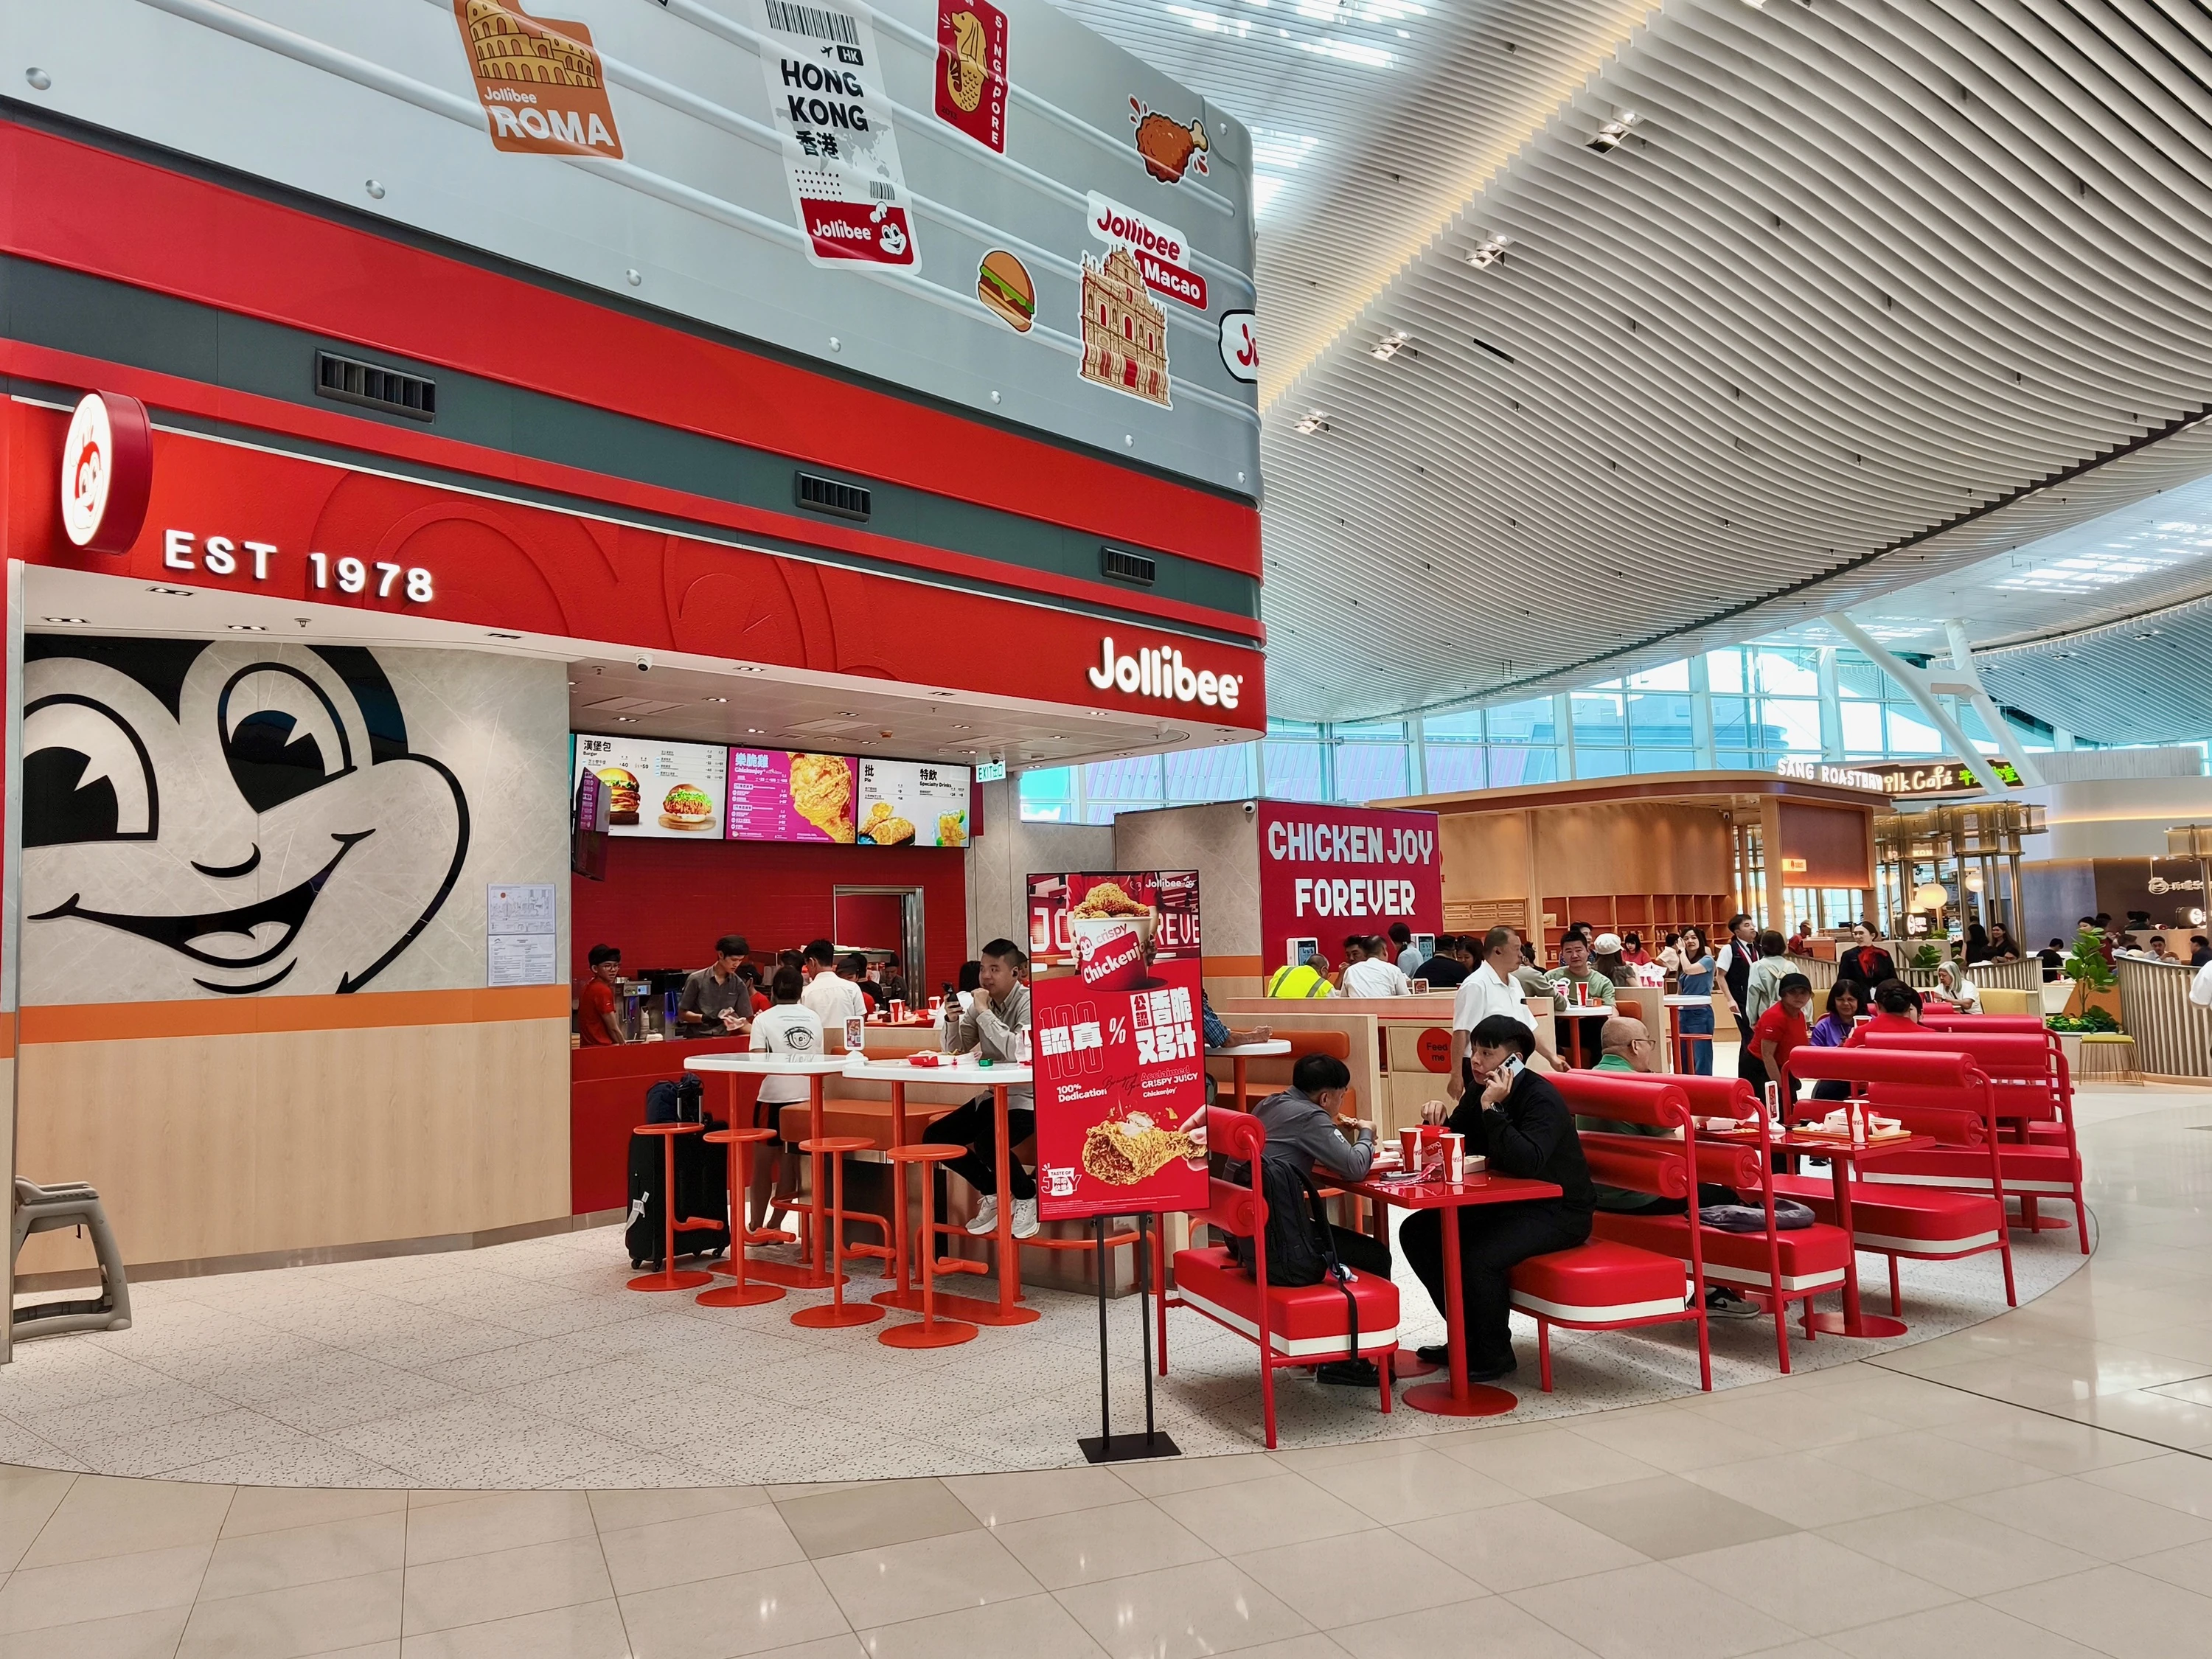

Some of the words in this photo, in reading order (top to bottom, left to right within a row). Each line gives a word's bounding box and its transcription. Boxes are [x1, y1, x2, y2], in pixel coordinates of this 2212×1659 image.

[842, 49, 859, 63] HK
[781, 58, 863, 97] HONG
[991, 15, 1004, 145] SINGAPORE
[484, 86, 537, 103] Jollibee
[787, 94, 869, 132] KONG
[489, 105, 615, 146] ROMA
[796, 131, 839, 160] 香港
[813, 218, 872, 240] Jollibee
[1097, 206, 1180, 261] Jollibee
[1144, 257, 1200, 299] Macao
[162, 529, 278, 580] EST
[308, 552, 434, 602] 1978
[1086, 636, 1242, 709] Jollibee
[583, 740, 611, 752] 漢堡包
[735, 752, 768, 768] 樂脆雞
[864, 764, 874, 777] 批
[1778, 757, 1814, 780] SANG
[919, 768, 938, 781] 特飲
[978, 766, 993, 780] EXIT
[1883, 772, 1911, 793] ilk
[1268, 821, 1384, 863] CHICKEN
[1387, 828, 1433, 865] JOY
[1145, 879, 1181, 888] Jollibee
[1295, 878, 1416, 917] FOREVER
[1096, 923, 1128, 944] crispy
[1150, 987, 1194, 1026] 香脆
[1040, 1020, 1104, 1057] 認真
[1135, 1021, 1197, 1065] 又多汁
[1426, 1041, 1448, 1051] Feed
[1141, 1065, 1189, 1082] Acclaimed
[1057, 1083, 1082, 1095] 100%
[1058, 1088, 1107, 1103] Dedication
[1143, 1087, 1177, 1098] Chickenjoy
